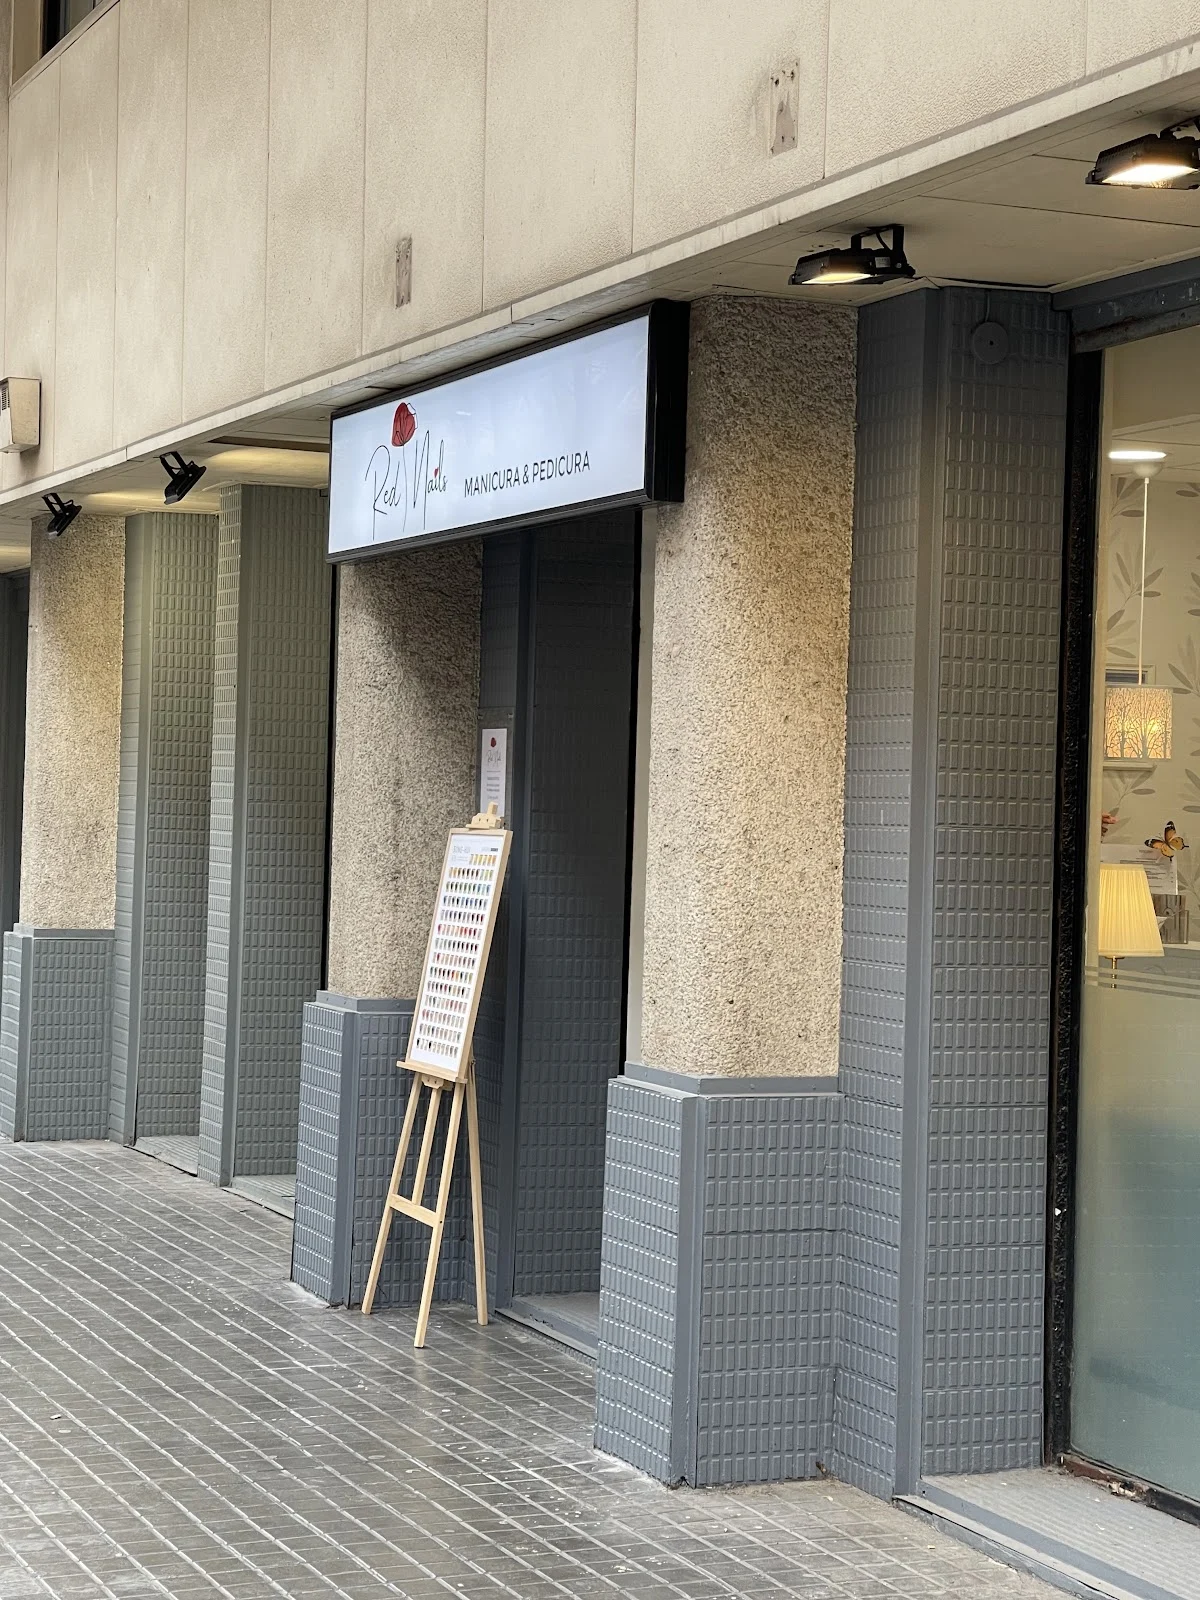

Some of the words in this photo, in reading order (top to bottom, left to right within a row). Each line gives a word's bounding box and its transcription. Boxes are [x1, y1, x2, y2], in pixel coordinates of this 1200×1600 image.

[365, 444, 401, 541] Red
[413, 430, 448, 530] Nails
[464, 465, 521, 498] MANICURA
[522, 466, 530, 485] &
[532, 450, 591, 483] PEDICURA
